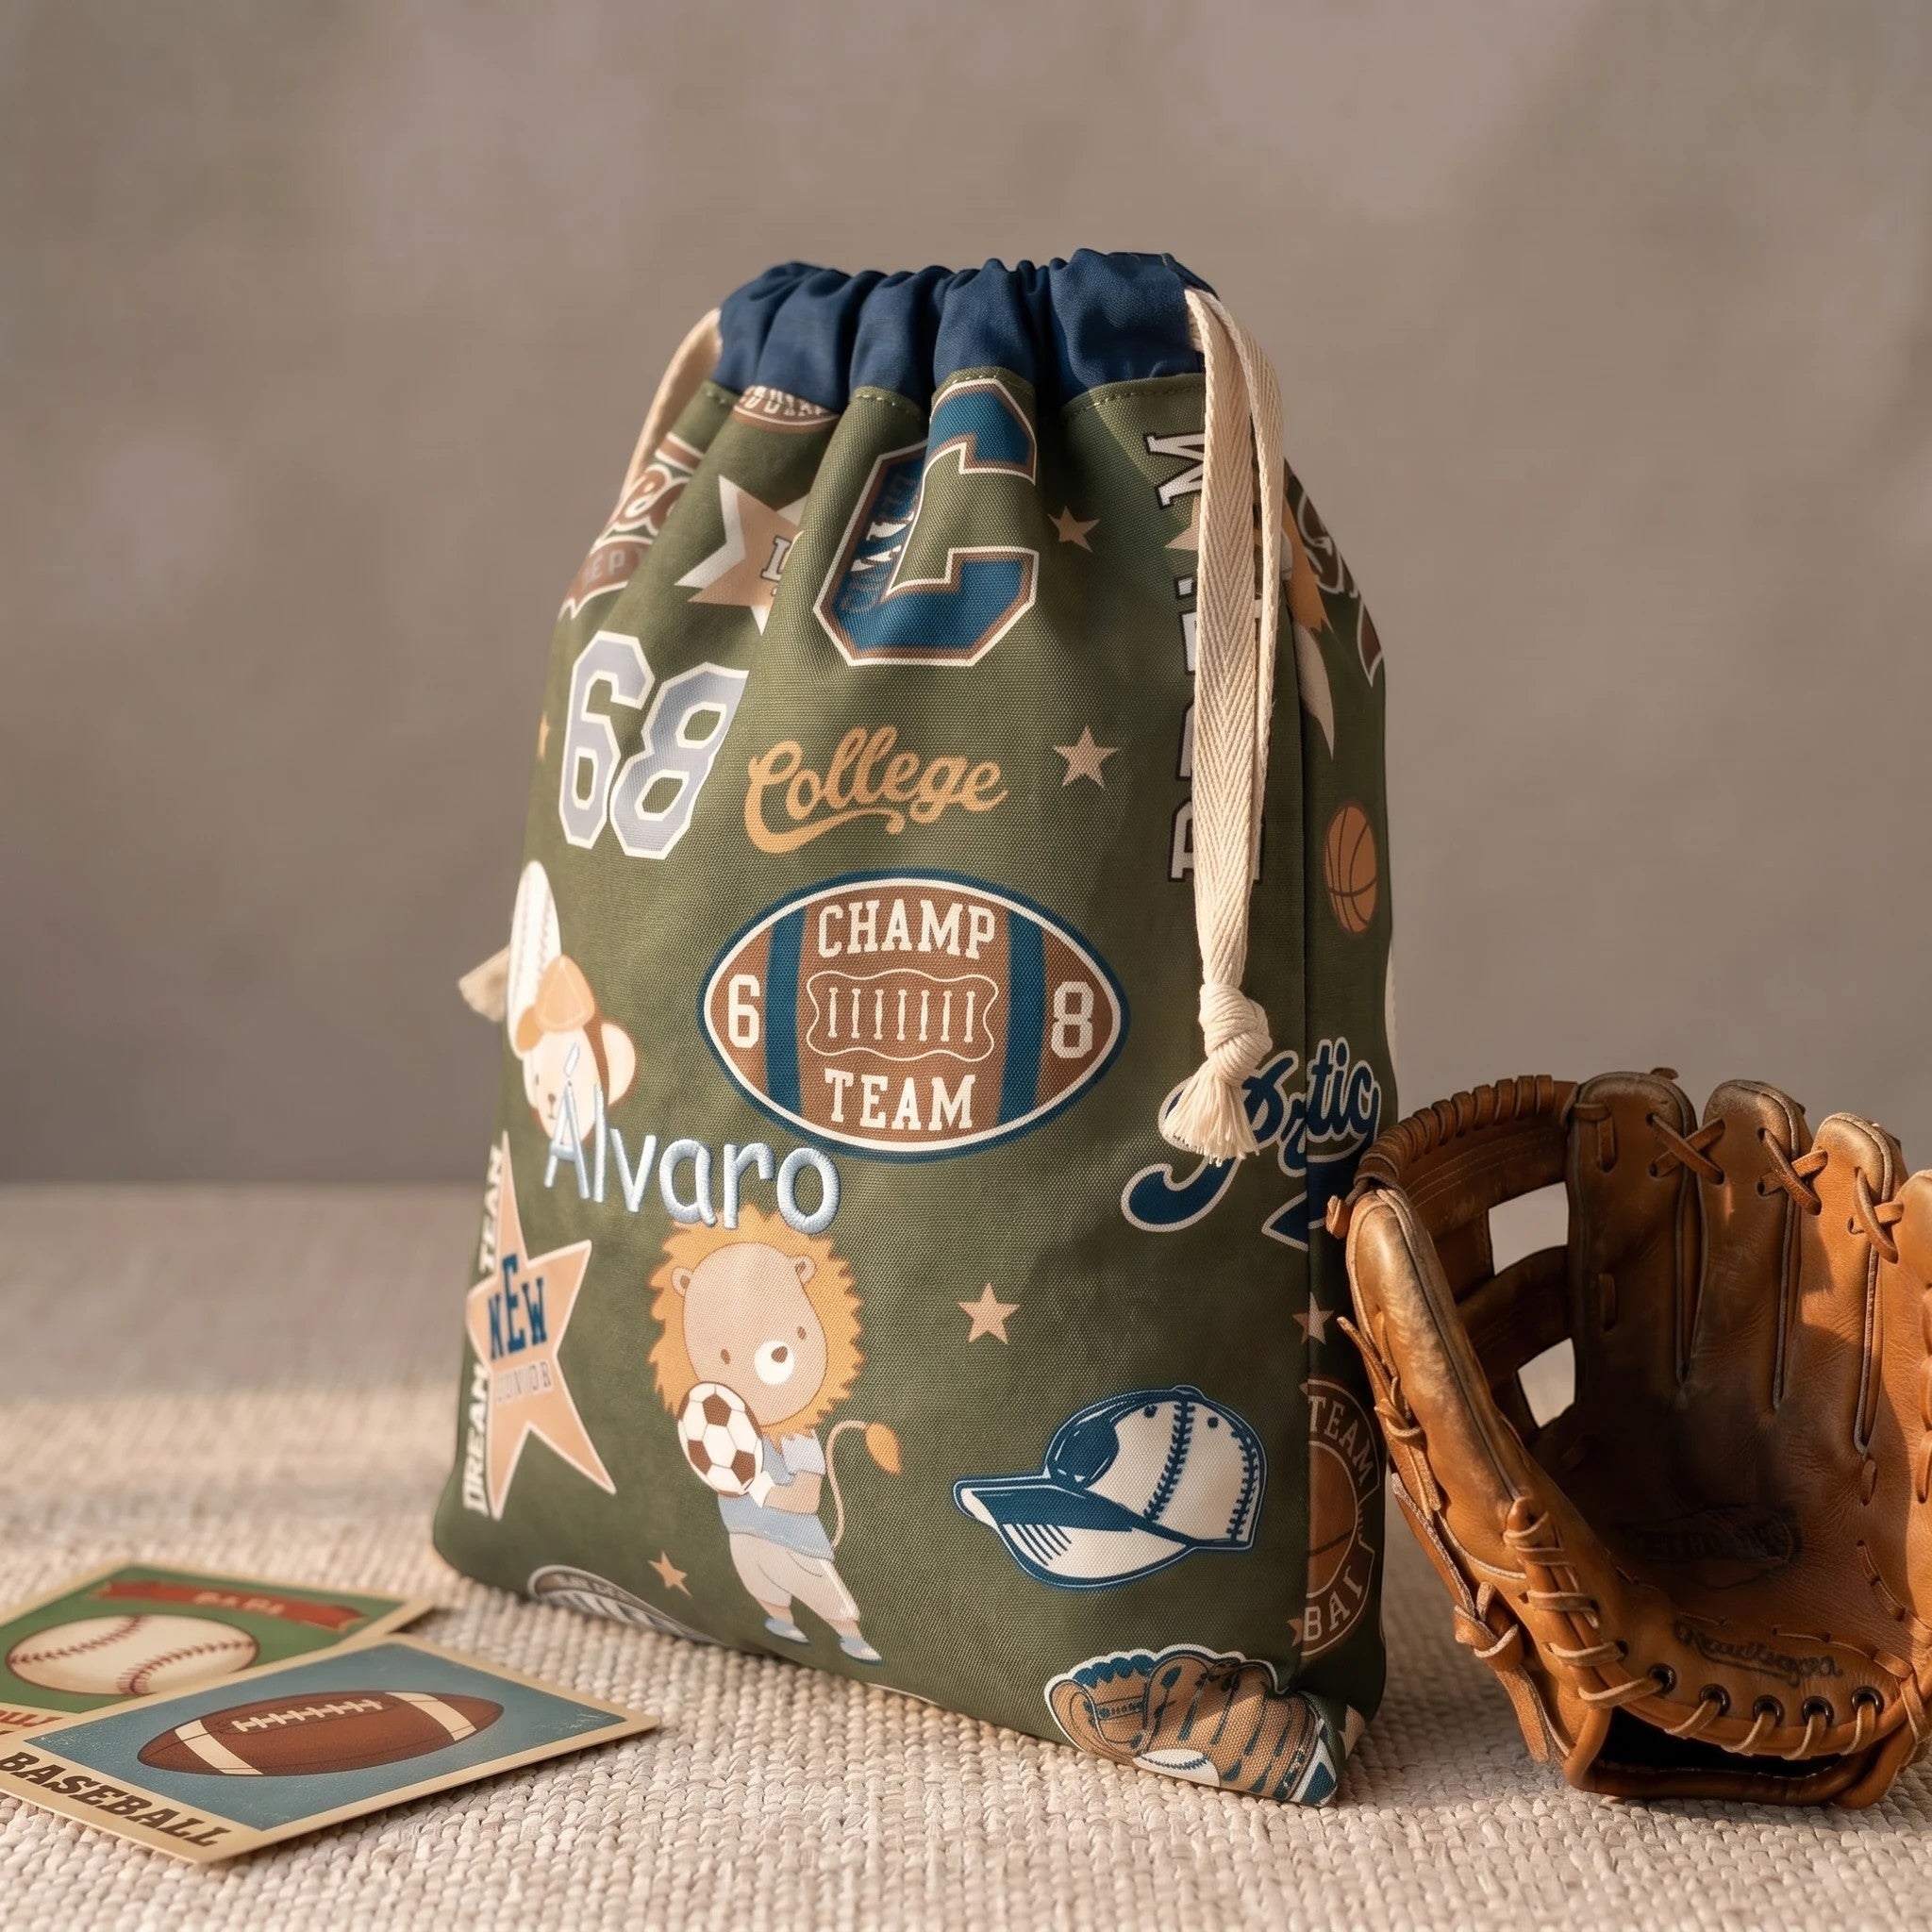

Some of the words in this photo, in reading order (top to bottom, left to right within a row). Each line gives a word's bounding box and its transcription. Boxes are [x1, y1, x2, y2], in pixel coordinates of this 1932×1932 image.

[558, 630, 750, 859] 68
[744, 725, 1008, 854] College
[818, 899, 996, 959] CHAMP
[727, 974, 760, 1048] 6
[1050, 981, 1094, 1059] 8
[824, 1068, 976, 1131] TEAM
[487, 1253, 547, 1361] NEW
[1307, 1395, 1374, 1487] TEAM
[0, 1752, 233, 1848] BASEBALL
